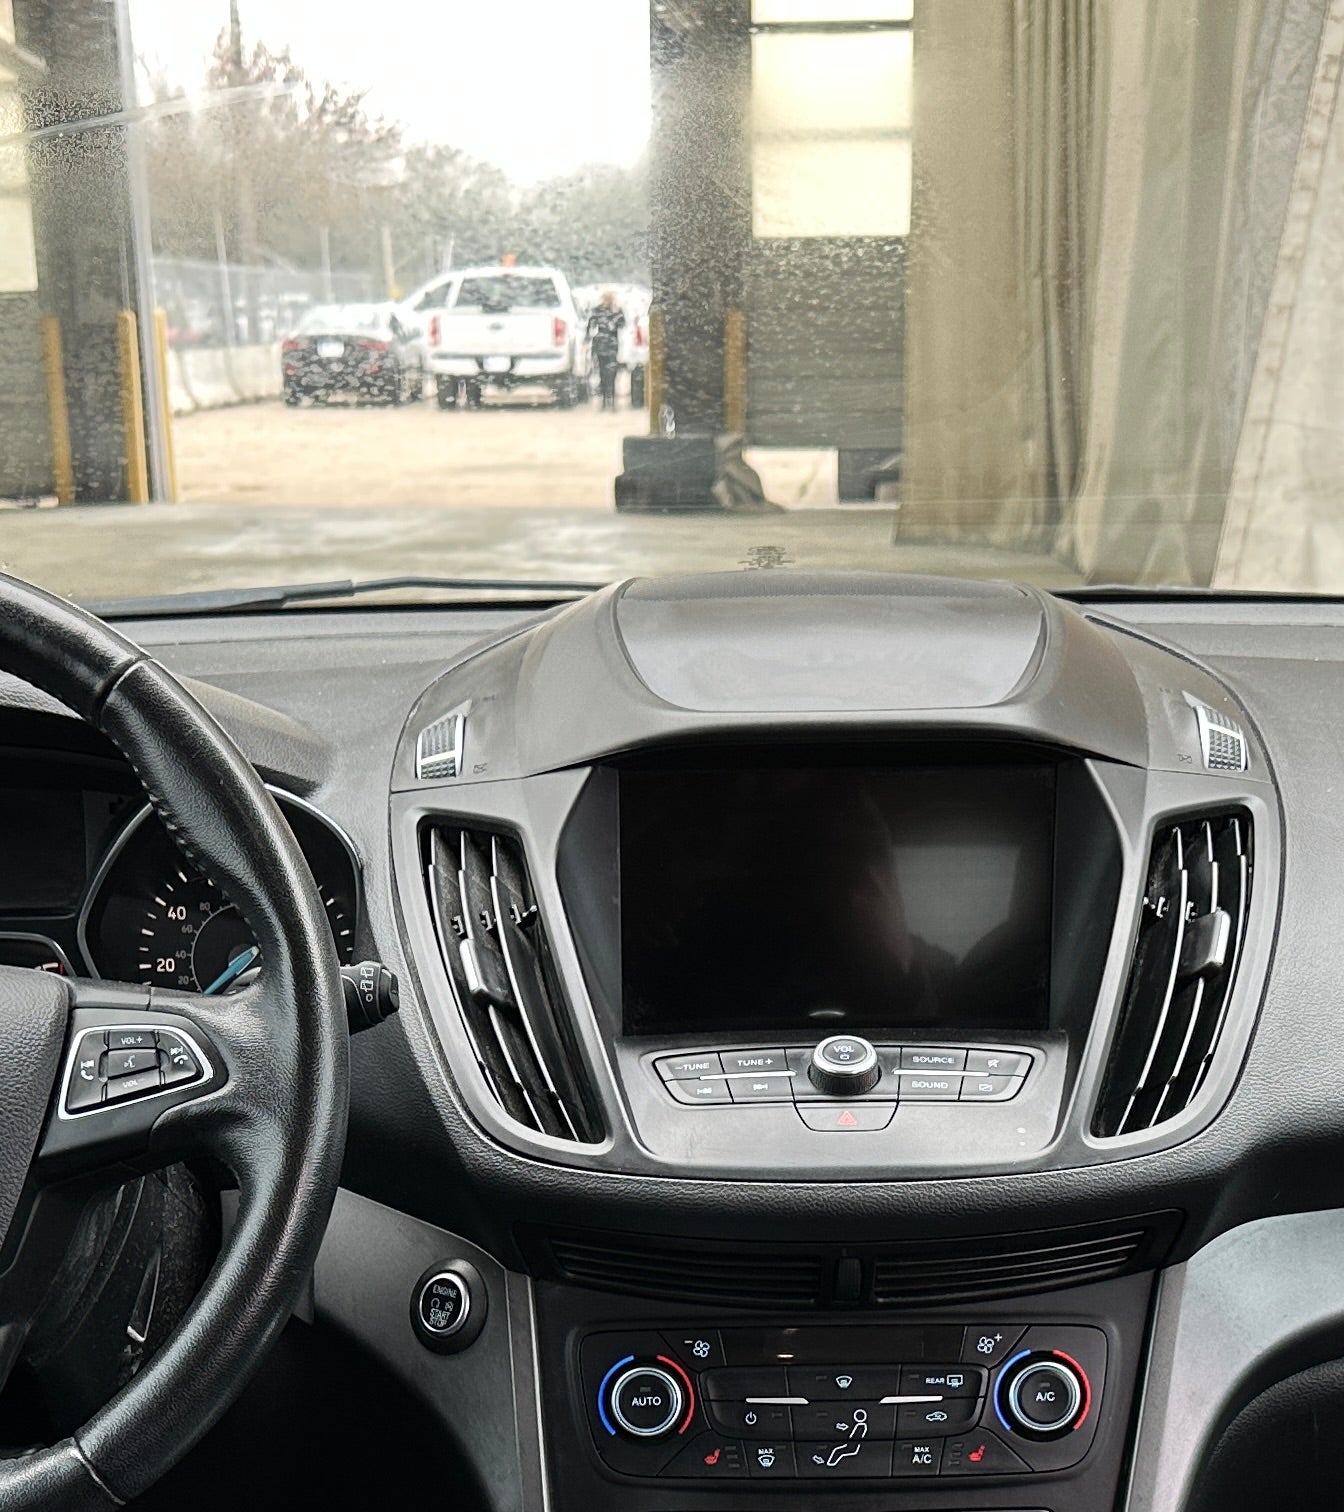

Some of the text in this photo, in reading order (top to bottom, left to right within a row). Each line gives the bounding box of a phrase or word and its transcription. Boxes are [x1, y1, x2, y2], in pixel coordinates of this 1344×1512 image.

[167, 906, 187, 920] 40
[156, 958, 175, 973] 20
[833, 1045, 855, 1053] VOL
[912, 1055, 955, 1065] SOURCE
[911, 1080, 949, 1090] SOUND
[925, 1377, 945, 1385] REAR
[631, 1396, 662, 1407] AUTO
[1035, 1391, 1056, 1402] A/C
[912, 1454, 932, 1464] A/C
